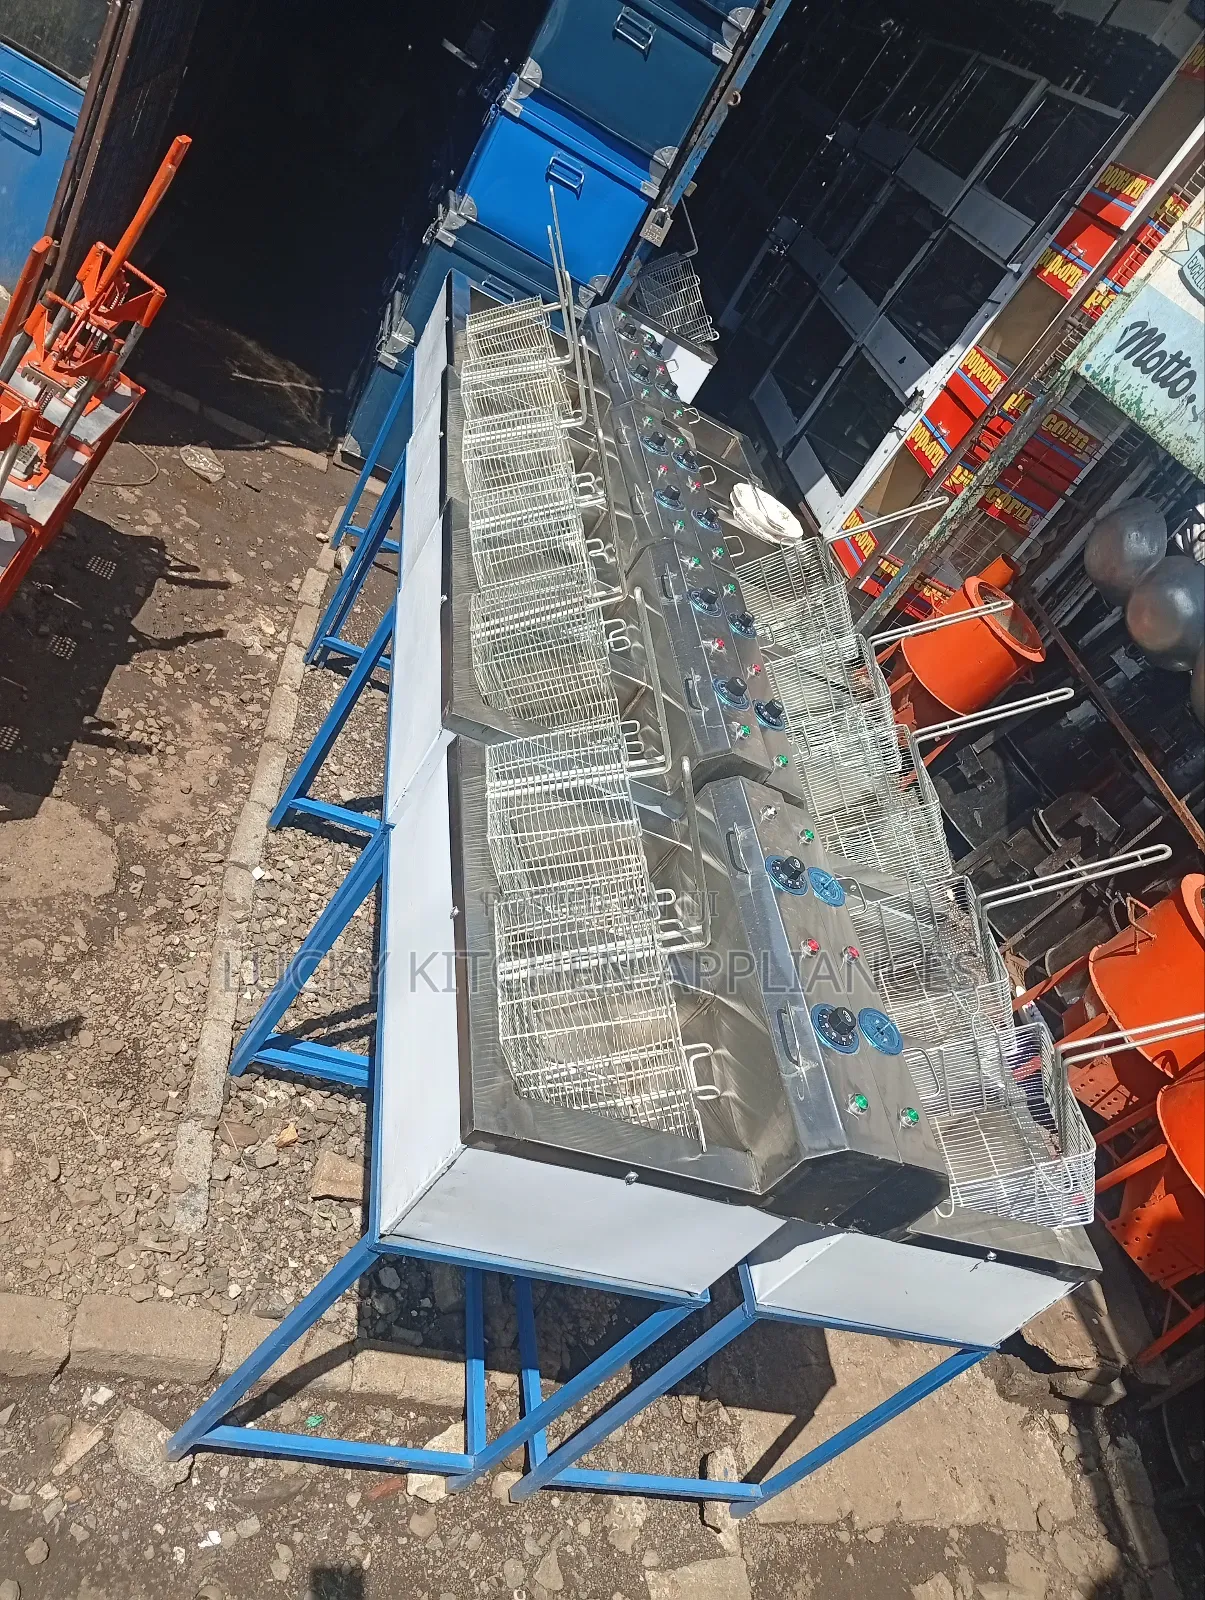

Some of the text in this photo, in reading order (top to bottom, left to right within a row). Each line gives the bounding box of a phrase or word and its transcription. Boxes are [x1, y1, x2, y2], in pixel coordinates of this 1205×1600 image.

[960, 347, 1002, 393] popcorn
[906, 421, 945, 467] popcorn
[842, 510, 876, 559] pocorn
